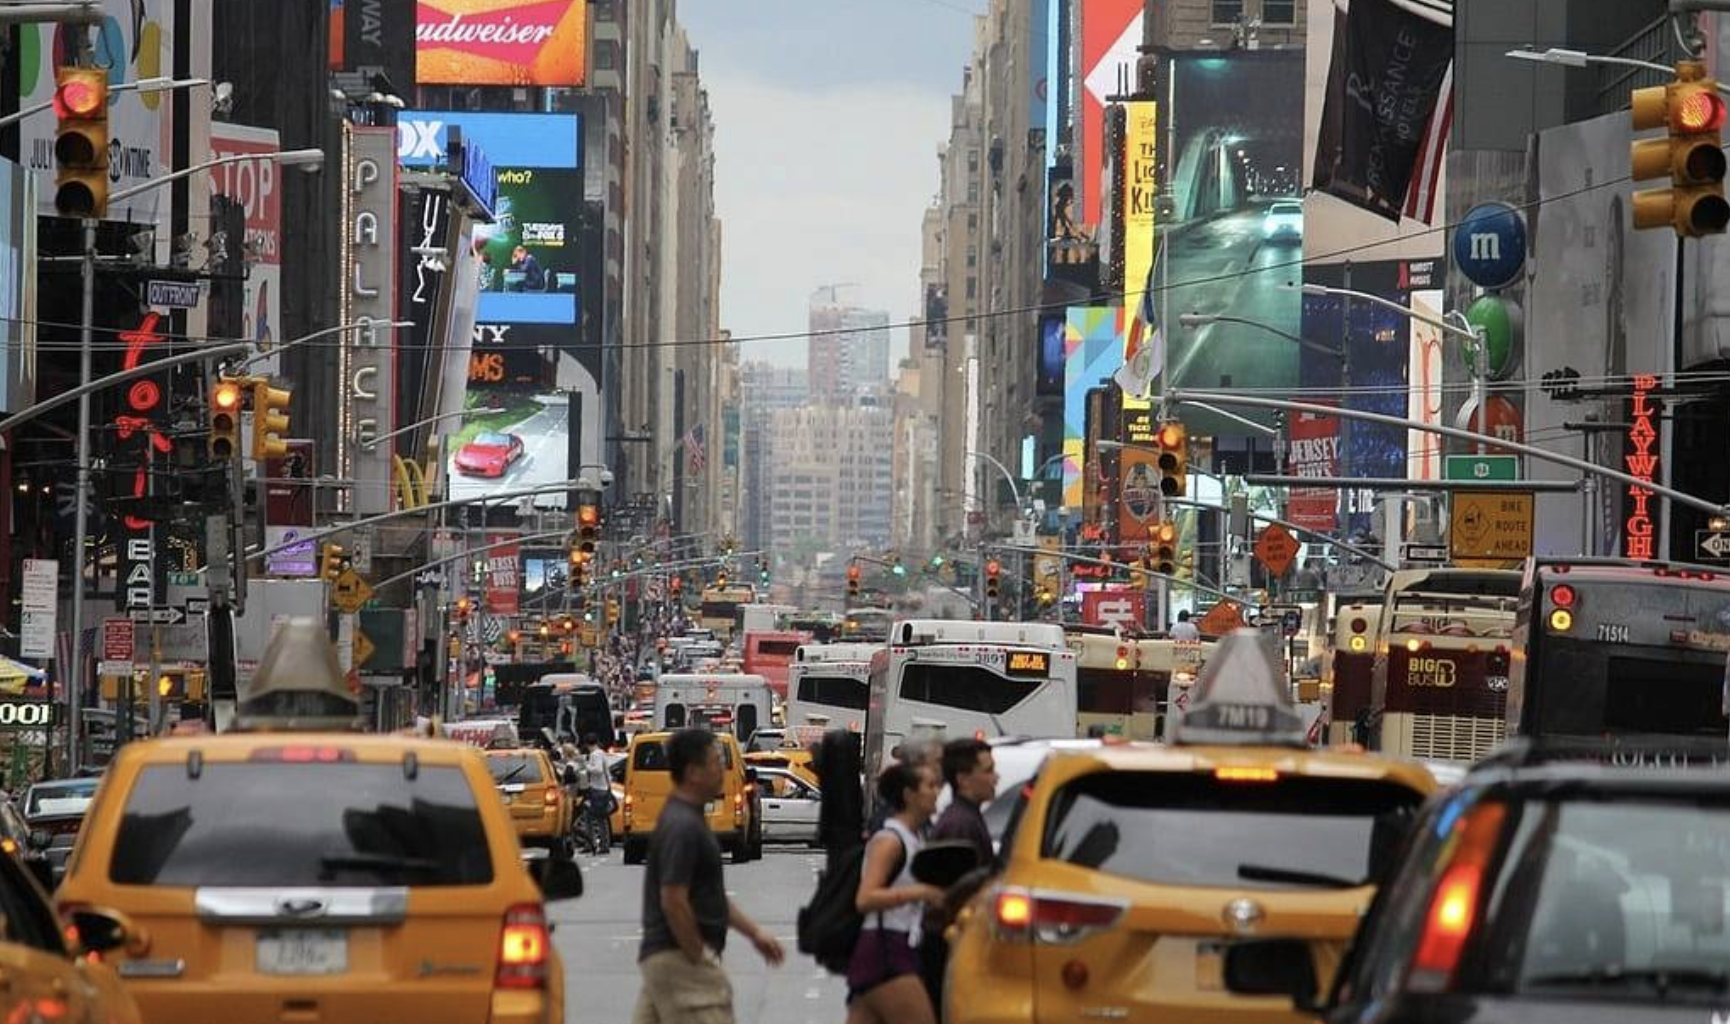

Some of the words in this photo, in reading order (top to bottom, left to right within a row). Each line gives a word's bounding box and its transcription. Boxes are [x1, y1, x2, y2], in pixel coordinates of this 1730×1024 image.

[497, 170, 533, 184] who?
[1469, 232, 1500, 259] m
[150, 285, 198, 306] OUTFRONT
[355, 160, 378, 450] PALACE
[1289, 438, 1339, 463] JERSEY
[1625, 375, 1657, 561] PLAYWRIGH
[1493, 540, 1526, 552] AHEAD
[1597, 625, 1629, 641] 71514
[1408, 659, 1437, 672] BIG
[1408, 674, 1435, 686] BUS
